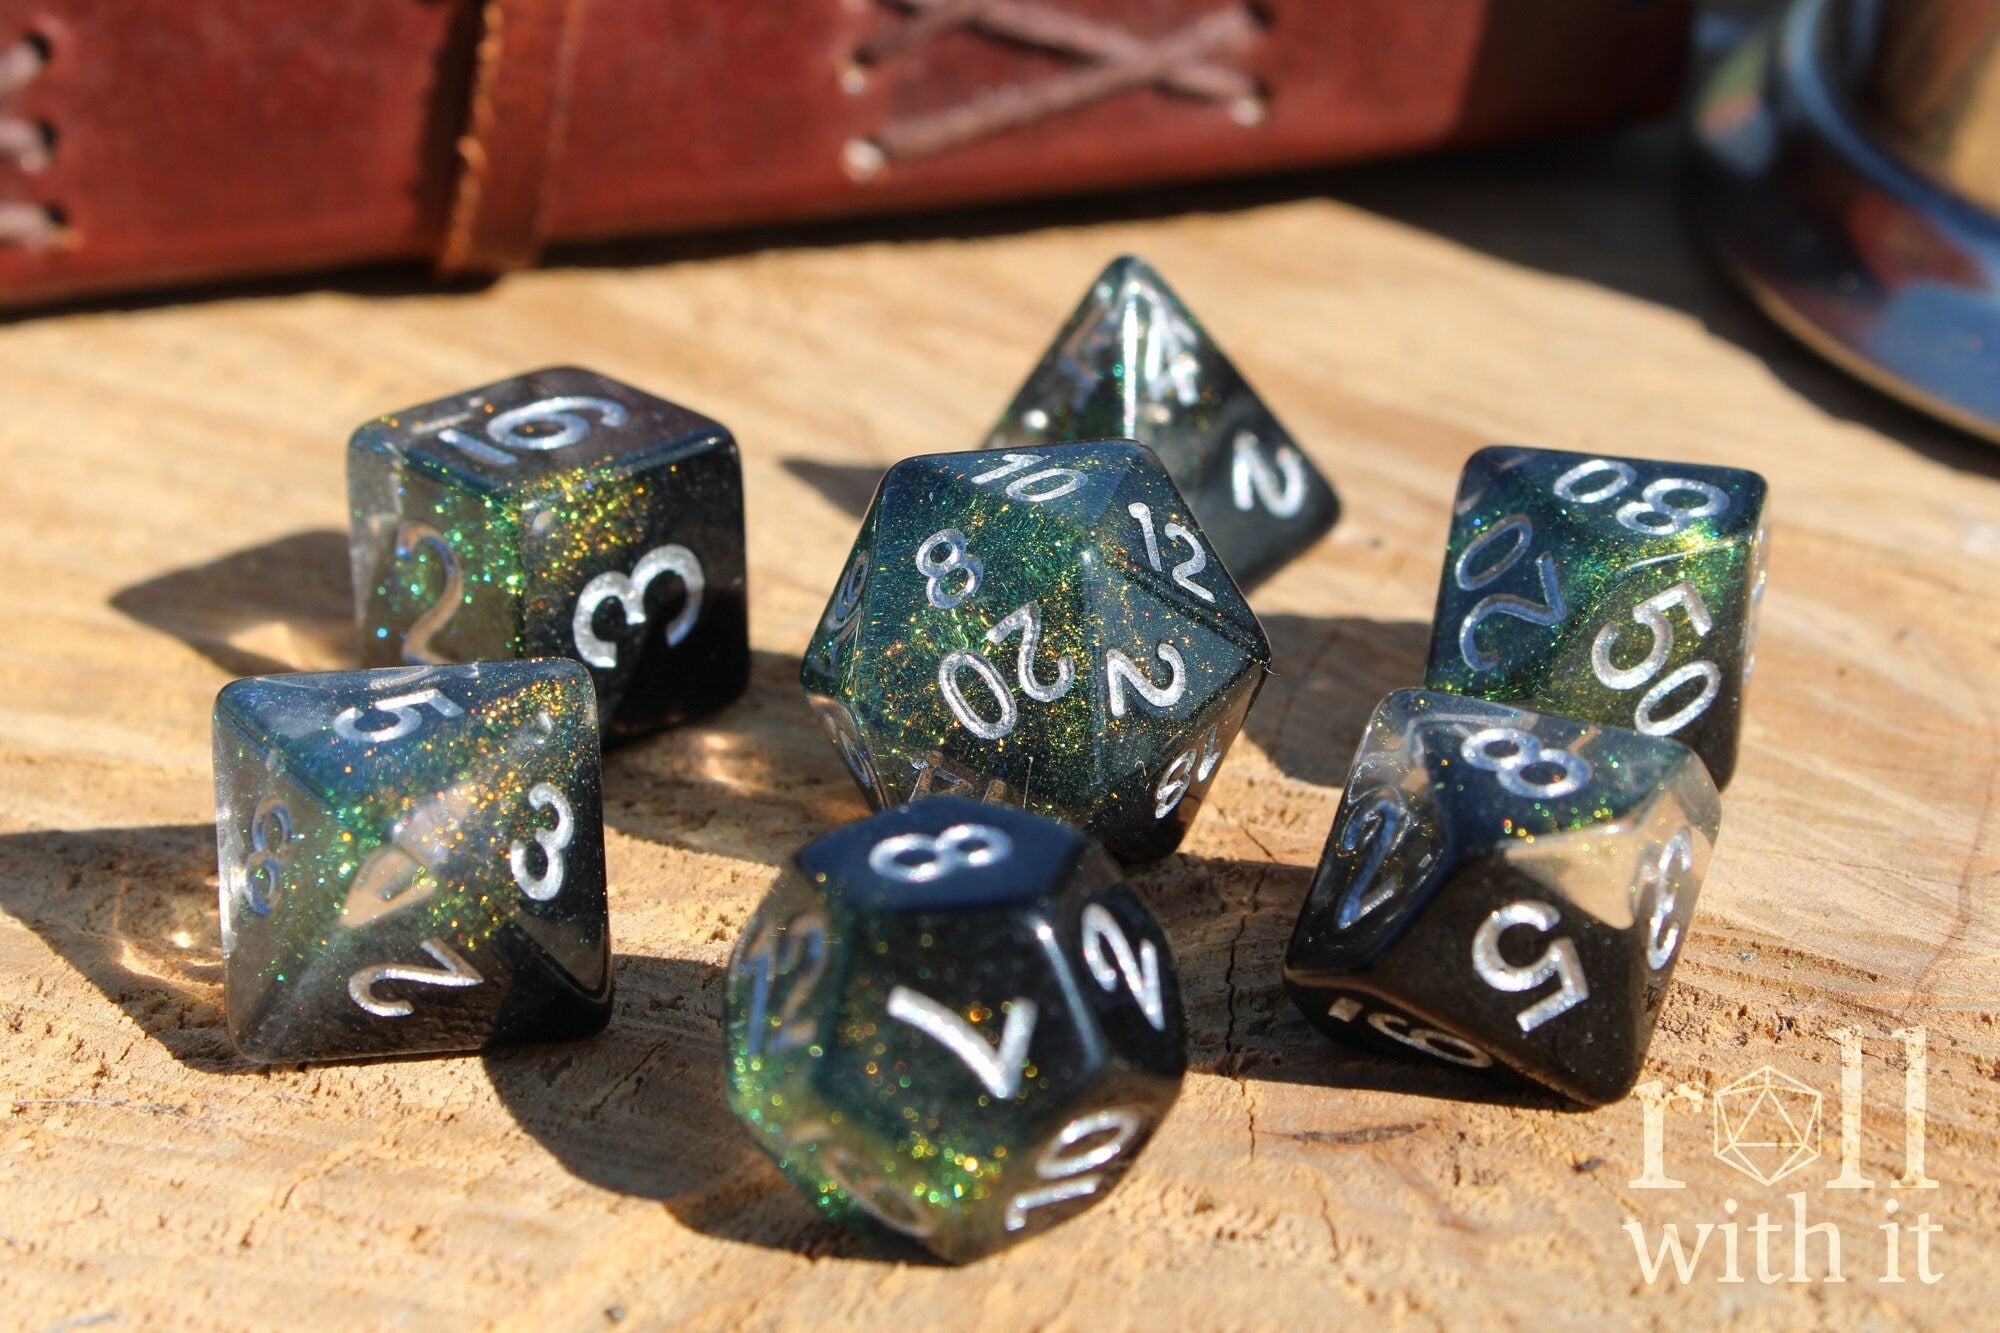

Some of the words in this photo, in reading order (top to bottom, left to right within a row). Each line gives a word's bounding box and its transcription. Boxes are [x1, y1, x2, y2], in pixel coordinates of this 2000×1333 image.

[971, 453, 1088, 501] 10
[1232, 433, 1307, 517] 2
[1553, 459, 1731, 536] 80
[572, 544, 705, 668] 3
[915, 527, 984, 610] 8
[1128, 502, 1216, 604] 12
[1455, 513, 1566, 672] 20
[938, 602, 1076, 740] 20
[1106, 642, 1187, 717] 2
[1591, 580, 1722, 737] 50
[332, 688, 465, 743] 5
[1460, 727, 1593, 799] 8
[245, 794, 293, 918] 8
[509, 783, 575, 901] 3
[868, 822, 1014, 883] 8
[1338, 798, 1401, 930] 2
[348, 937, 486, 1018] 2
[1080, 902, 1166, 1032] 2
[1471, 900, 1590, 1033] 5
[1005, 1109, 1143, 1231] 10
